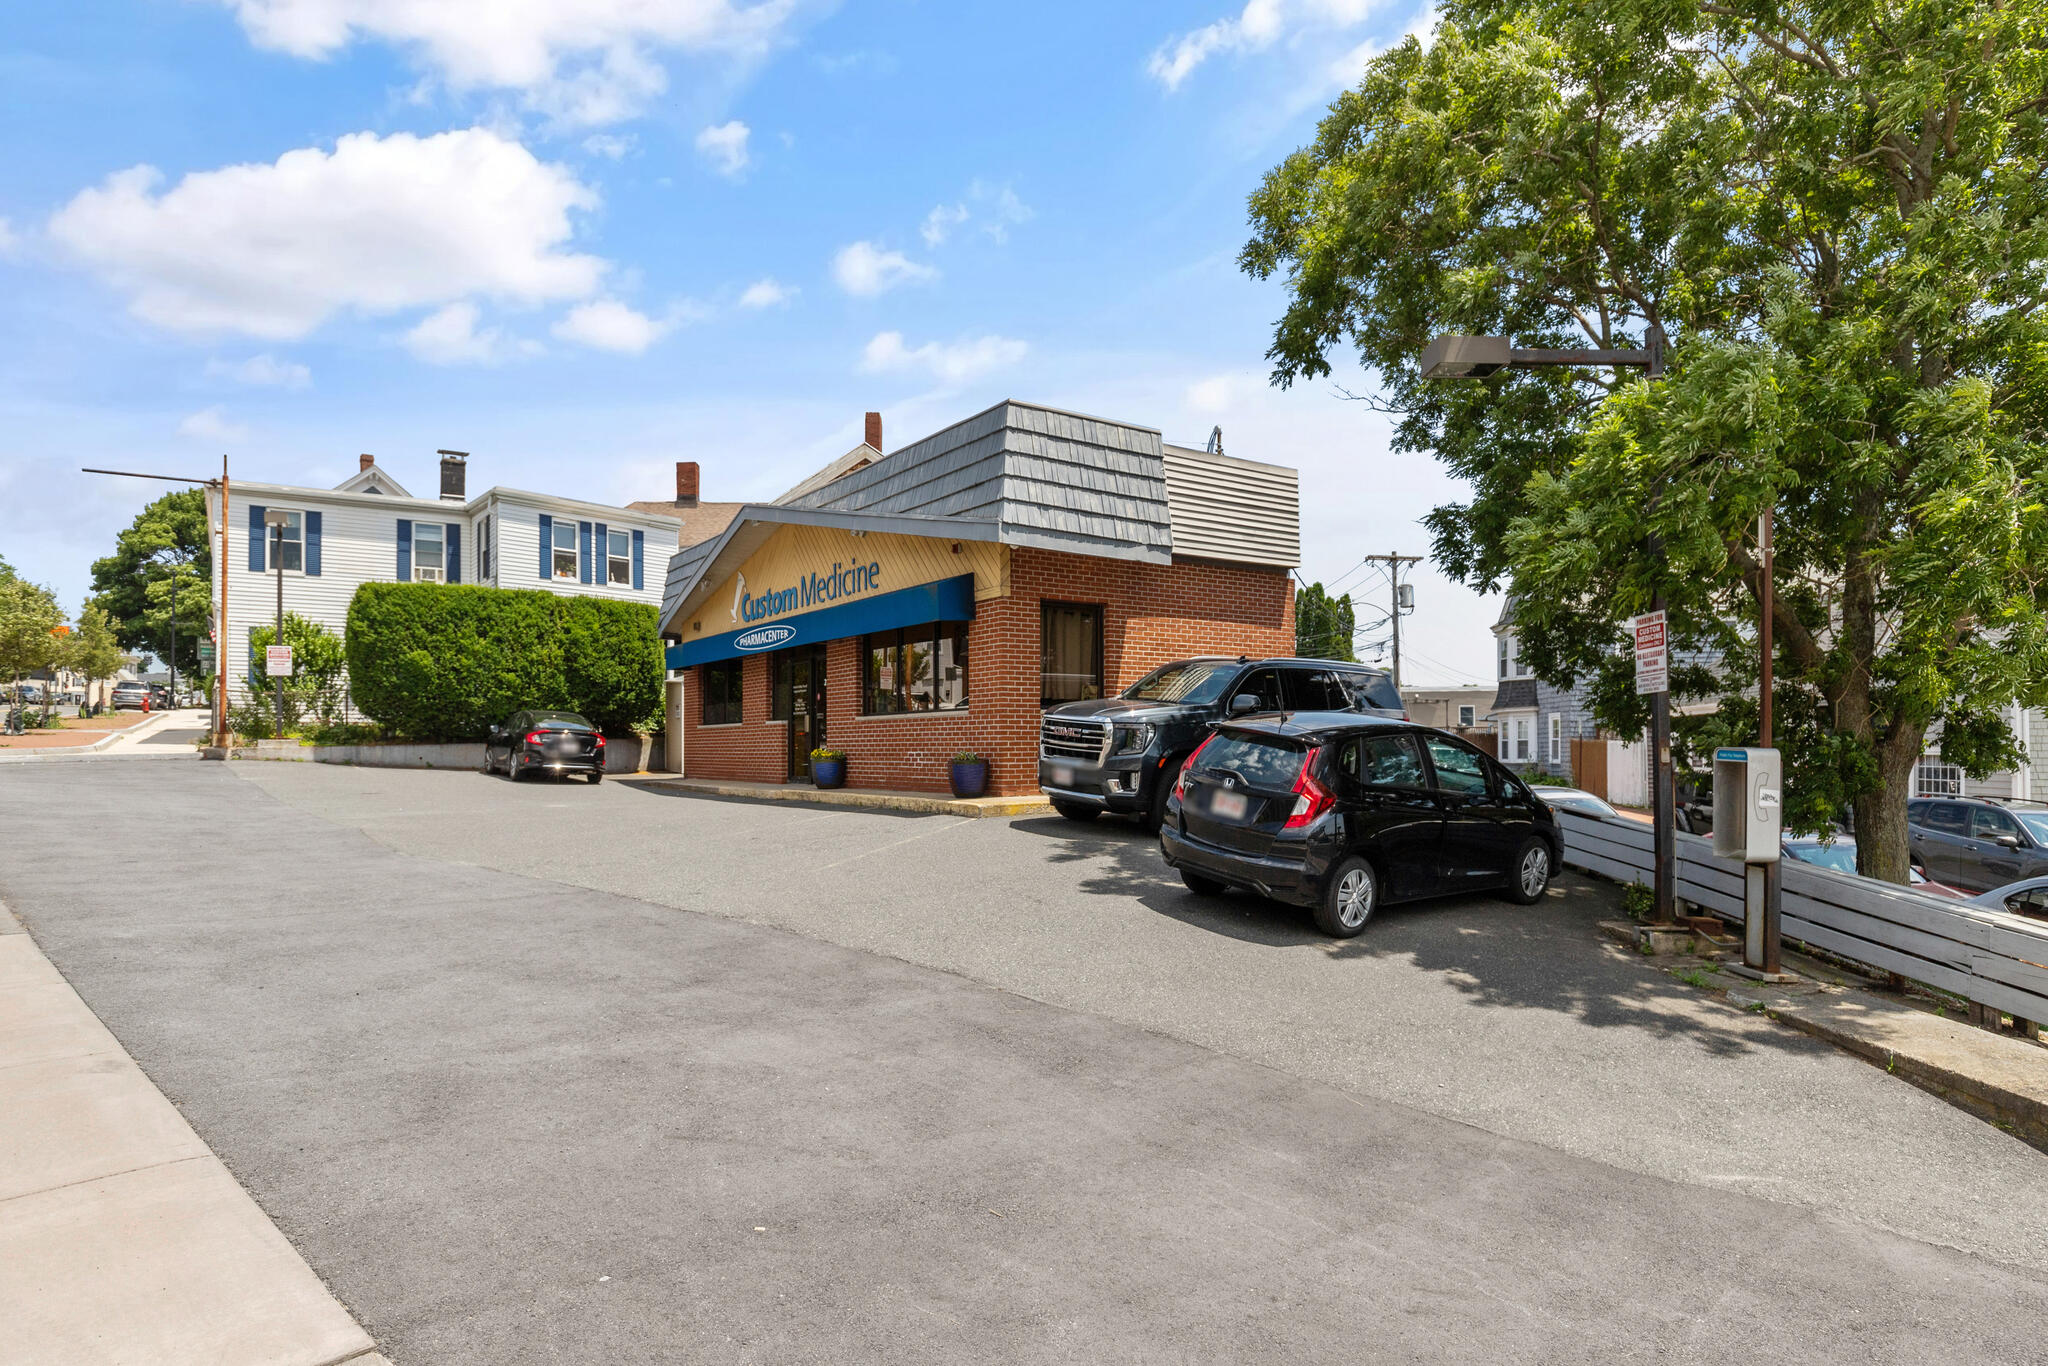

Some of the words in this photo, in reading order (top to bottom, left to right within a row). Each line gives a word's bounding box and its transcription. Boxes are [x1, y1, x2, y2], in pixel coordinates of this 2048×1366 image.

[741, 586, 798, 623] Custom
[800, 557, 880, 608] Medicine
[1637, 616, 1654, 626] PARKING
[1639, 624, 1661, 636] CUSTOM
[739, 628, 789, 647] PHARMACENTER
[1638, 631, 1663, 642] MEDICINE
[1054, 726, 1082, 737] GMC
